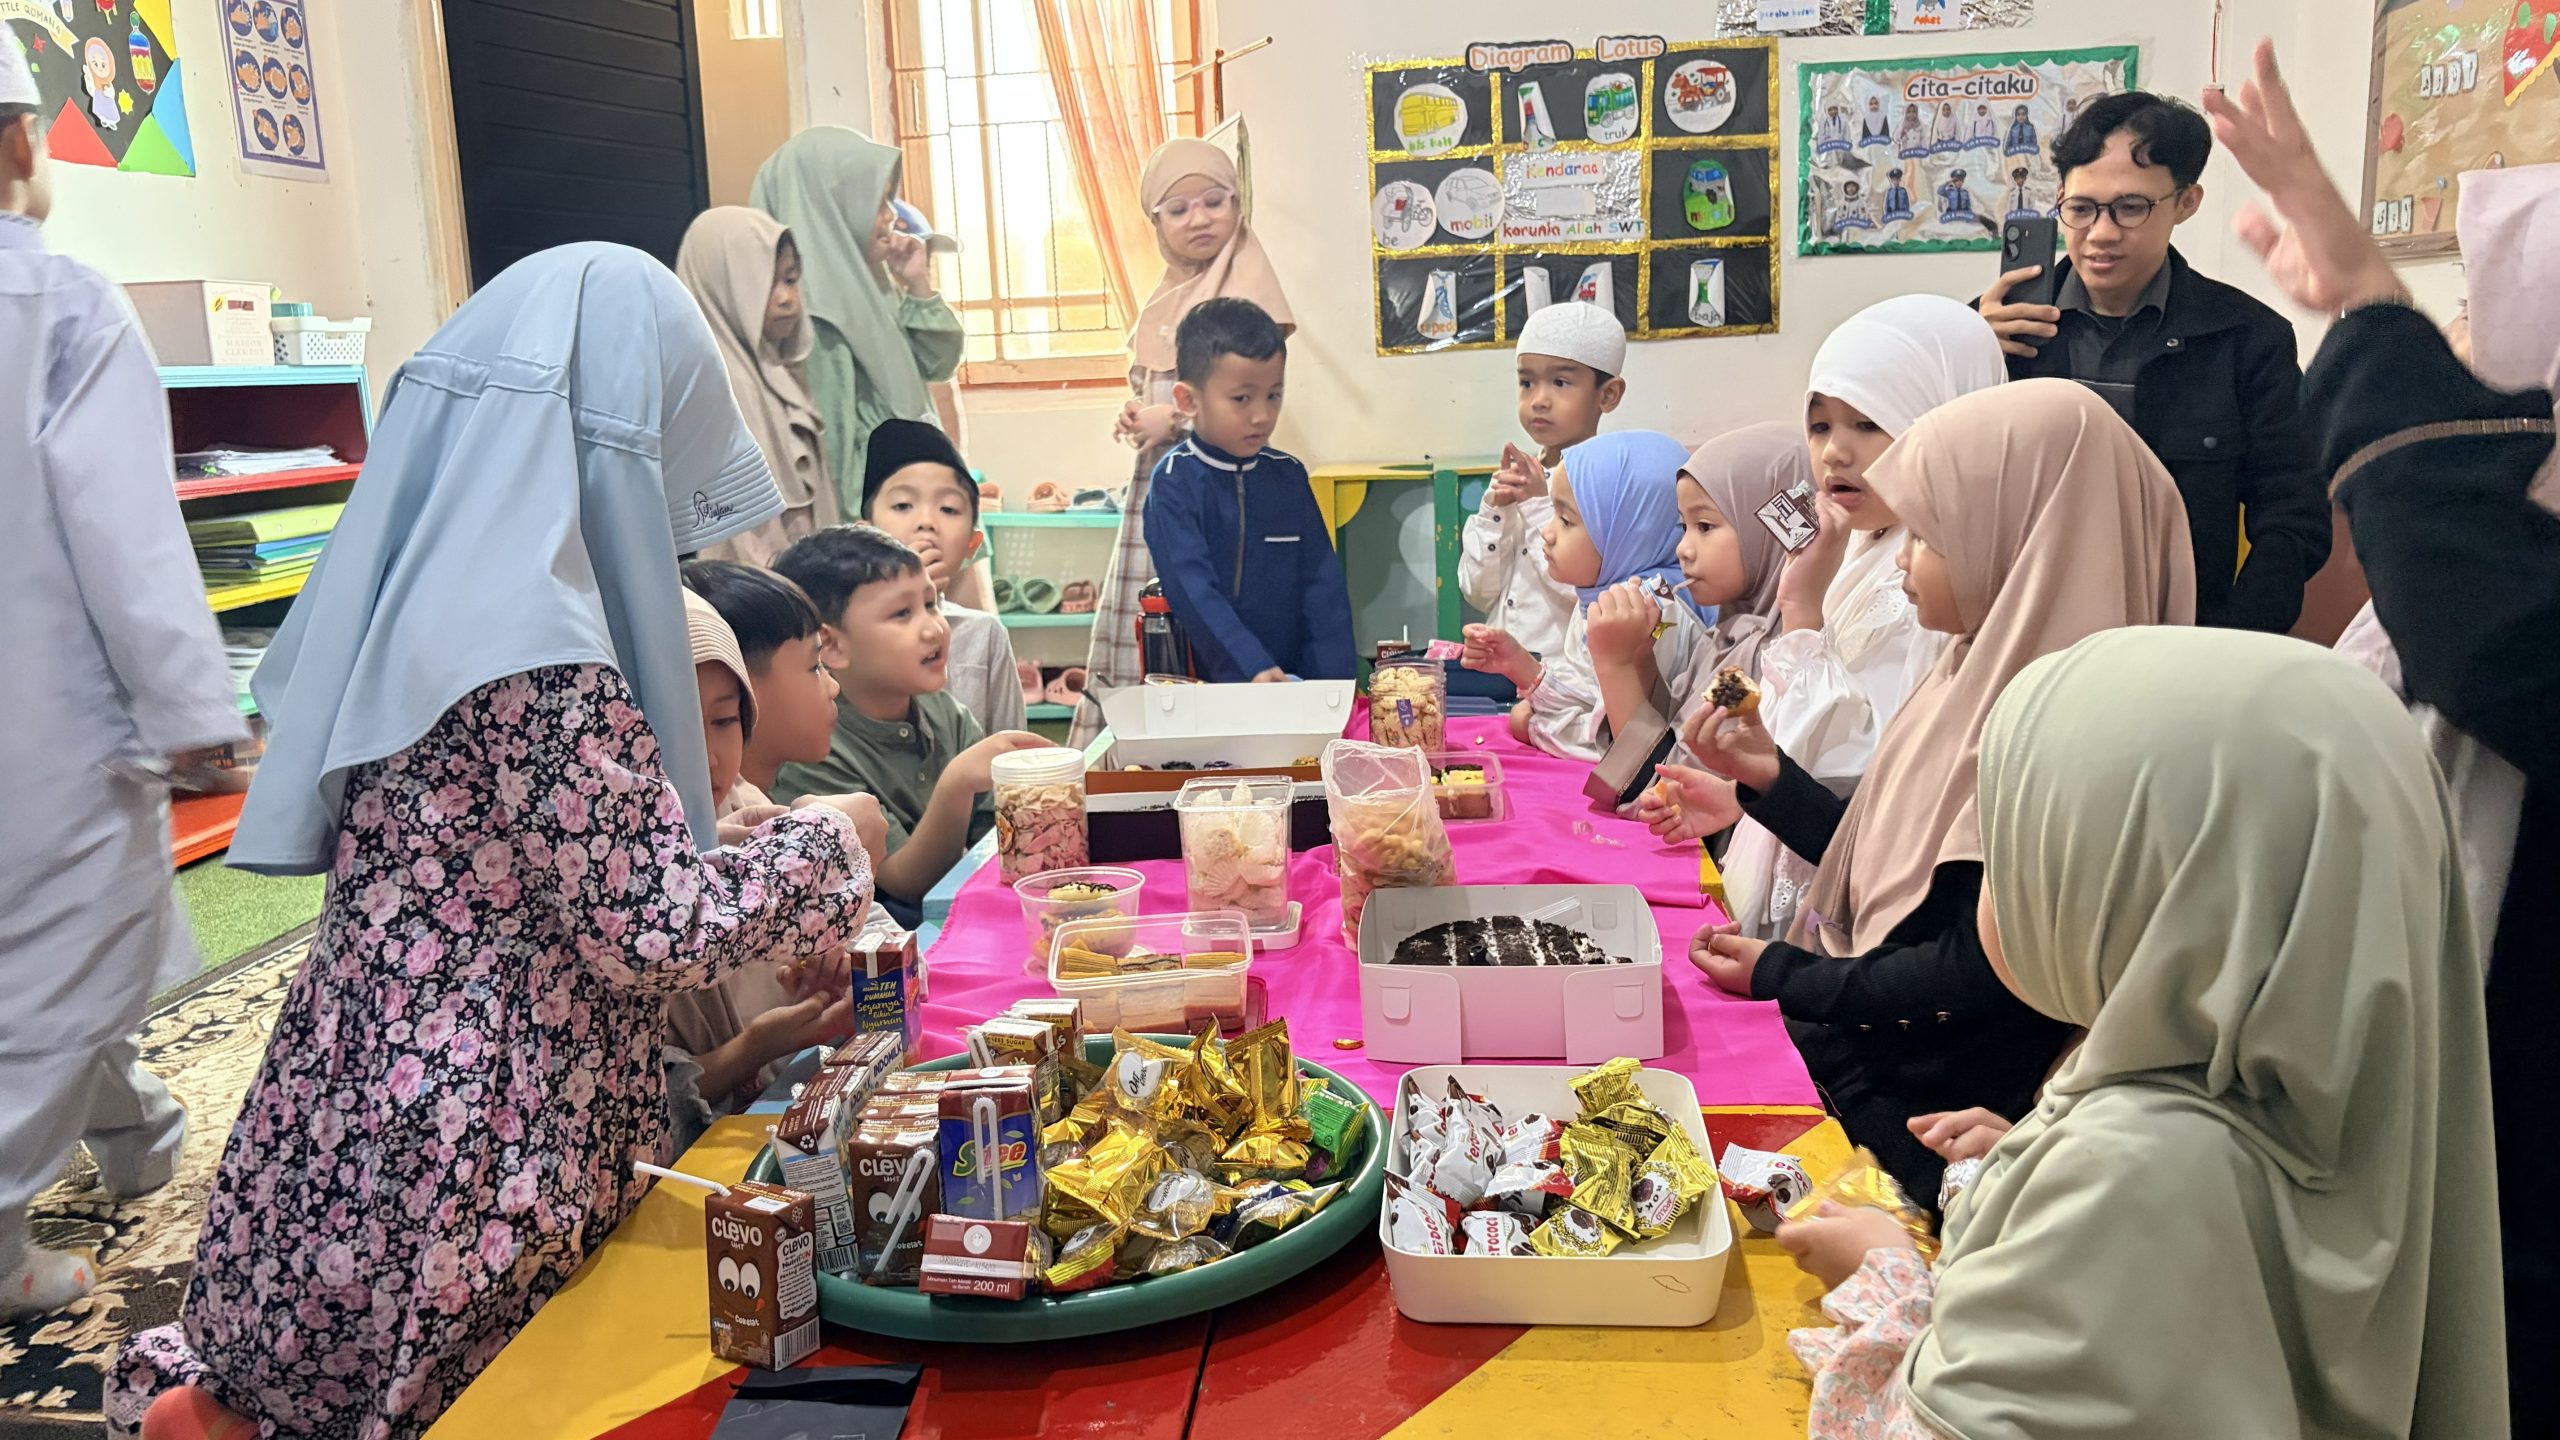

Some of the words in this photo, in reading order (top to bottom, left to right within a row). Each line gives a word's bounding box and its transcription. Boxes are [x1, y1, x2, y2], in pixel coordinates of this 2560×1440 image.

[1471, 44, 1569, 70] Diagram
[1600, 38, 1662, 58] Lotus
[1907, 74, 2034, 98] cita-citaku
[1604, 128, 1628, 141] truk
[1450, 214, 1493, 231] mobil
[1608, 220, 1644, 234] SWT
[730, 1241, 745, 1251] UHT
[973, 1280, 995, 1292] 200
[996, 1282, 1010, 1293] ml
